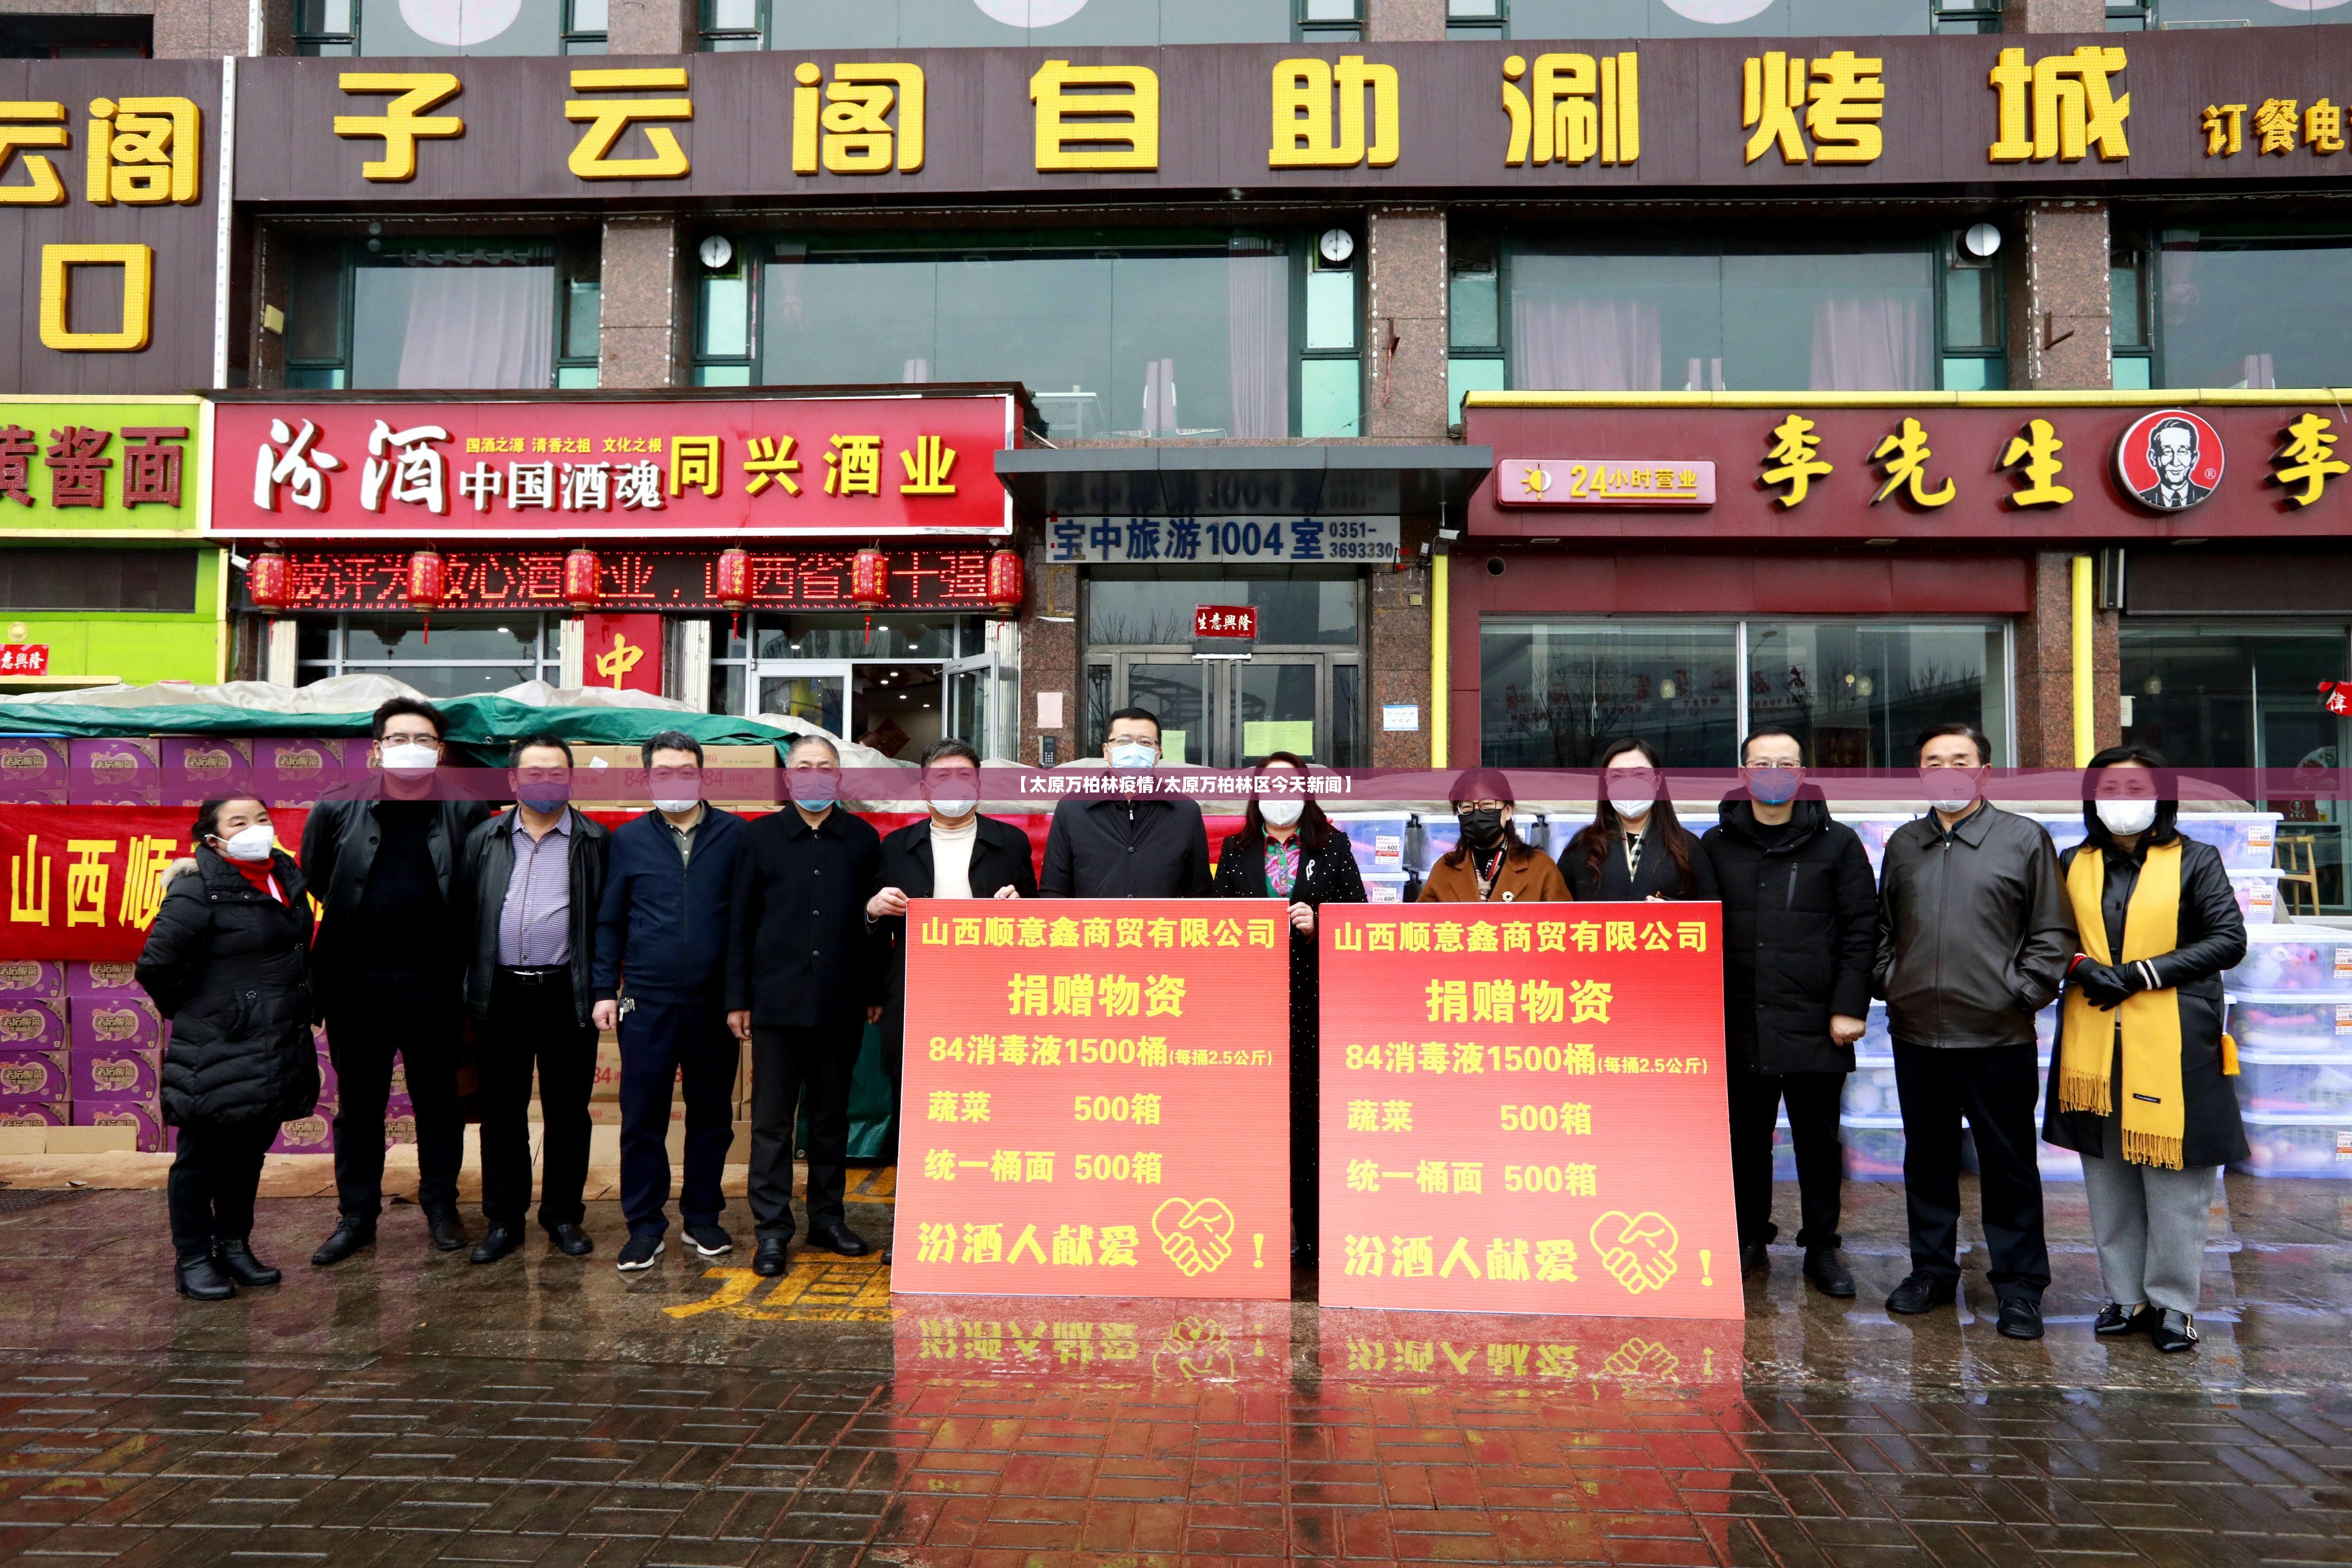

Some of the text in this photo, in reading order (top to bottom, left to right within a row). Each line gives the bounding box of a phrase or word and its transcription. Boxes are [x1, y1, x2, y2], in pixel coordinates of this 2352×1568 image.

[334, 46, 2130, 181] 子云阁自助涮烤城
[2202, 98, 2352, 156] 订餐电
[40, 244, 152, 351] 口
[254, 418, 450, 515] 汾酒
[466, 436, 663, 453] 国酒之源 清香之祖 文化之根
[669, 433, 958, 497] 同兴酒业
[1759, 414, 2074, 508] 李先生
[2272, 413, 2351, 508] 李
[459, 459, 666, 511] 中国酒魂
[1053, 517, 1325, 561] 宝中旅游1004室
[1329, 521, 1377, 538] 0351-
[1329, 542, 1394, 559] 3693330
[1198, 612, 1253, 631] 生意興隆
[596, 632, 644, 690] 中
[703, 769, 724, 787] 84
[922, 916, 1276, 948] 山西顺意鑫商贸有限公司
[1334, 921, 1707, 952] 山西顺意鑫商贸有限公司
[1008, 973, 1187, 1017] 捐赠物资
[1425, 979, 1614, 1024] 捐赠物资
[928, 1091, 1162, 1125] 蔬菜 500箱
[1347, 1100, 1592, 1135] 蔬菜 500箱
[924, 1149, 1055, 1183] 统一桶面
[1074, 1151, 1163, 1184] 500箱
[1347, 1160, 1597, 1197] 统一桶面 500箱
[916, 1221, 1140, 1267] 汾酒人献爱
[1344, 1234, 1579, 1283] 汾酒人献爱
